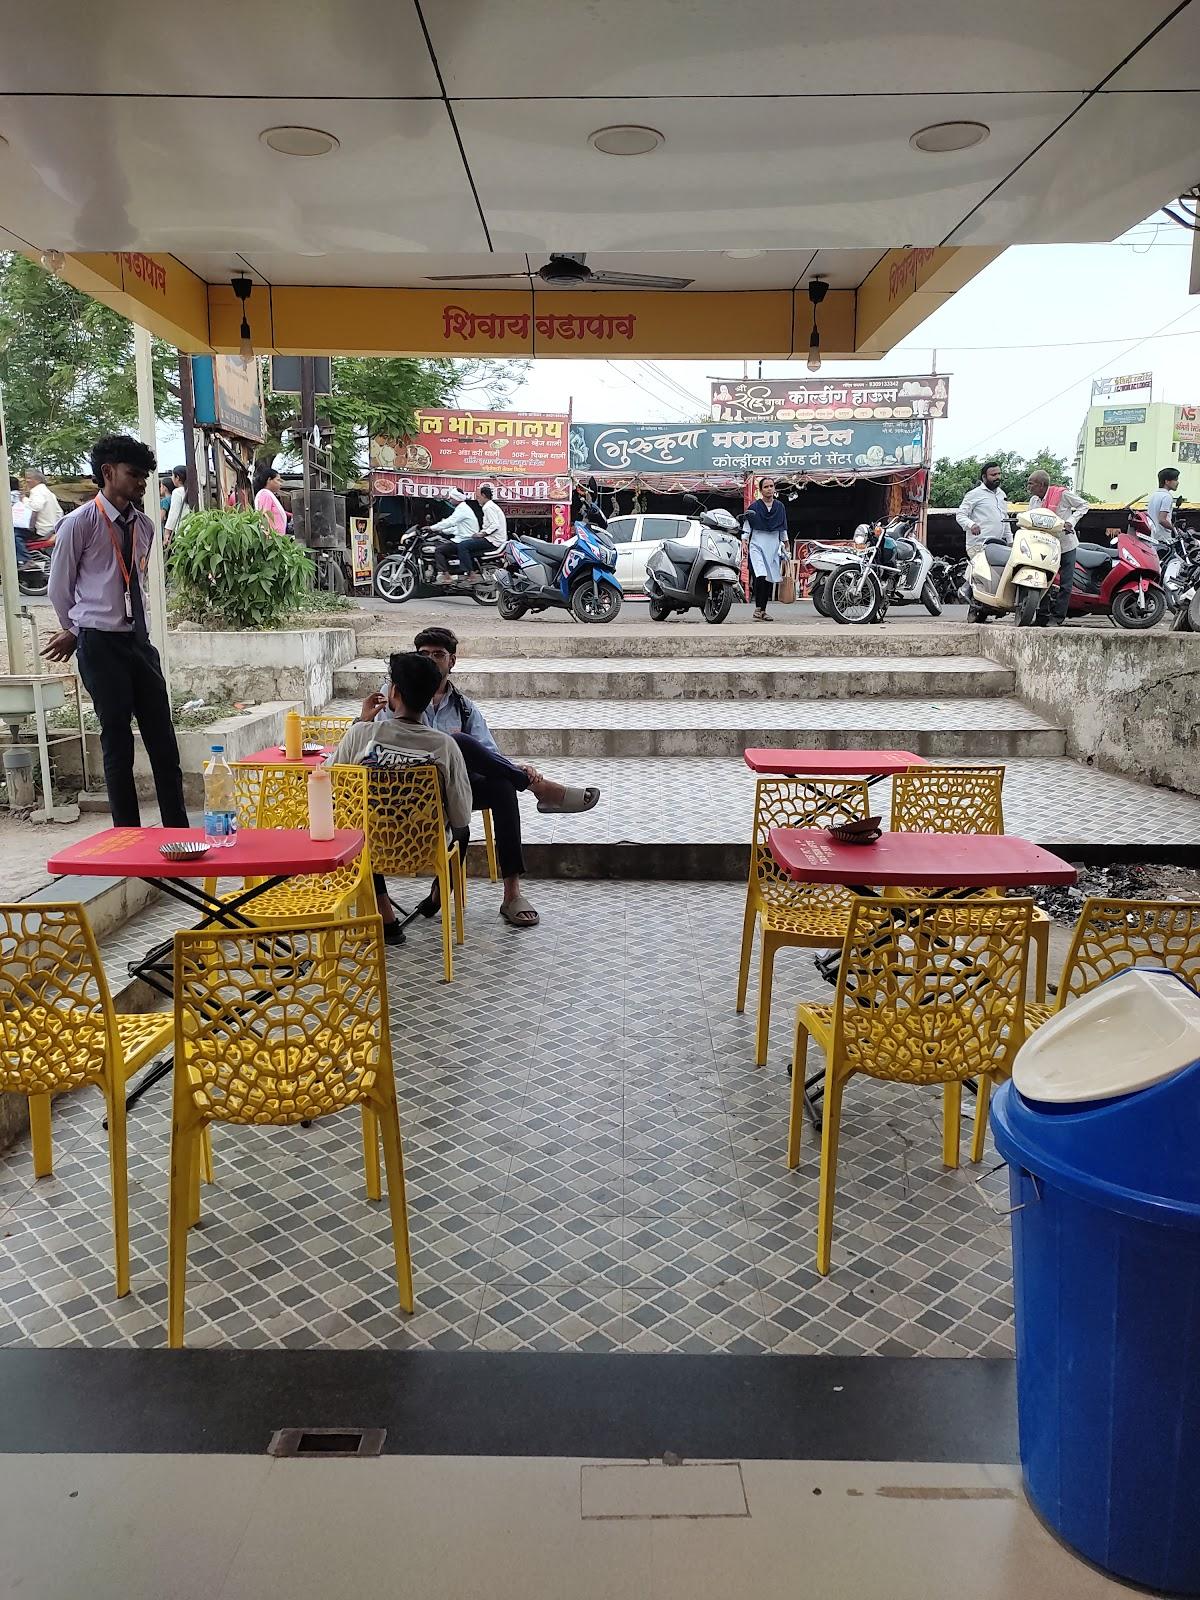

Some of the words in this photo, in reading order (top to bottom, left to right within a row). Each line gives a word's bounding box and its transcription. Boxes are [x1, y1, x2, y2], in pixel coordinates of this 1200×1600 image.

[443, 305, 530, 340] शिवाय
[535, 313, 637, 340] वडापाव
[735, 384, 748, 395] श्री
[851, 389, 898, 407] हाऊस
[1180, 408, 1196, 420] NS
[448, 412, 565, 439] भोजनालय
[711, 430, 782, 449] मराठा
[785, 424, 855, 448] हॉटेल
[809, 451, 822, 465] टी
[825, 450, 854, 465] सेंटर
